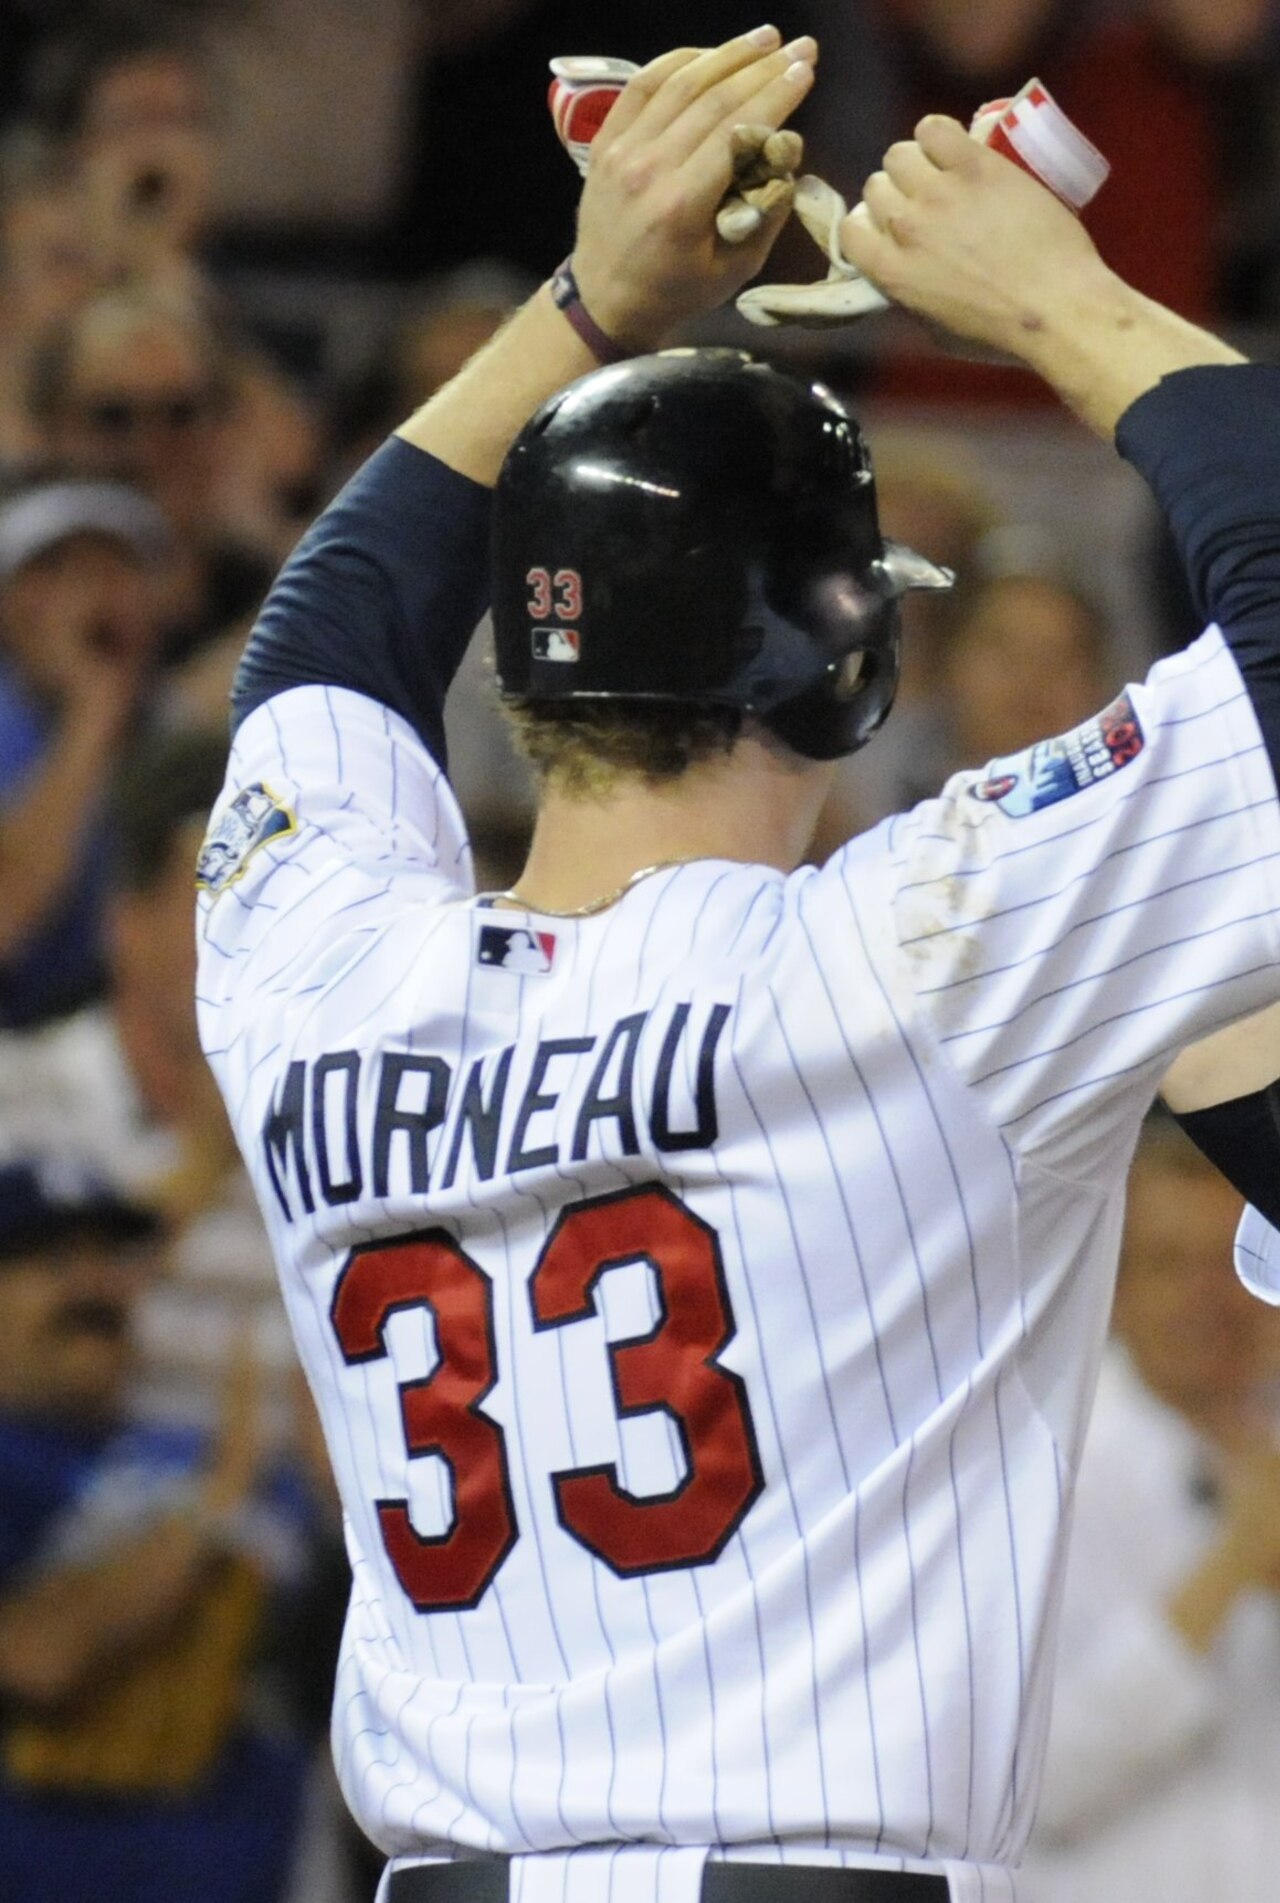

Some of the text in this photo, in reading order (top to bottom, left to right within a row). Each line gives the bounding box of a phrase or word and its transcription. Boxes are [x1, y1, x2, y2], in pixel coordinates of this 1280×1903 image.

[526, 567, 583, 620] 33
[262, 1003, 731, 1223] MORNEAU
[329, 1180, 766, 1614] 33
